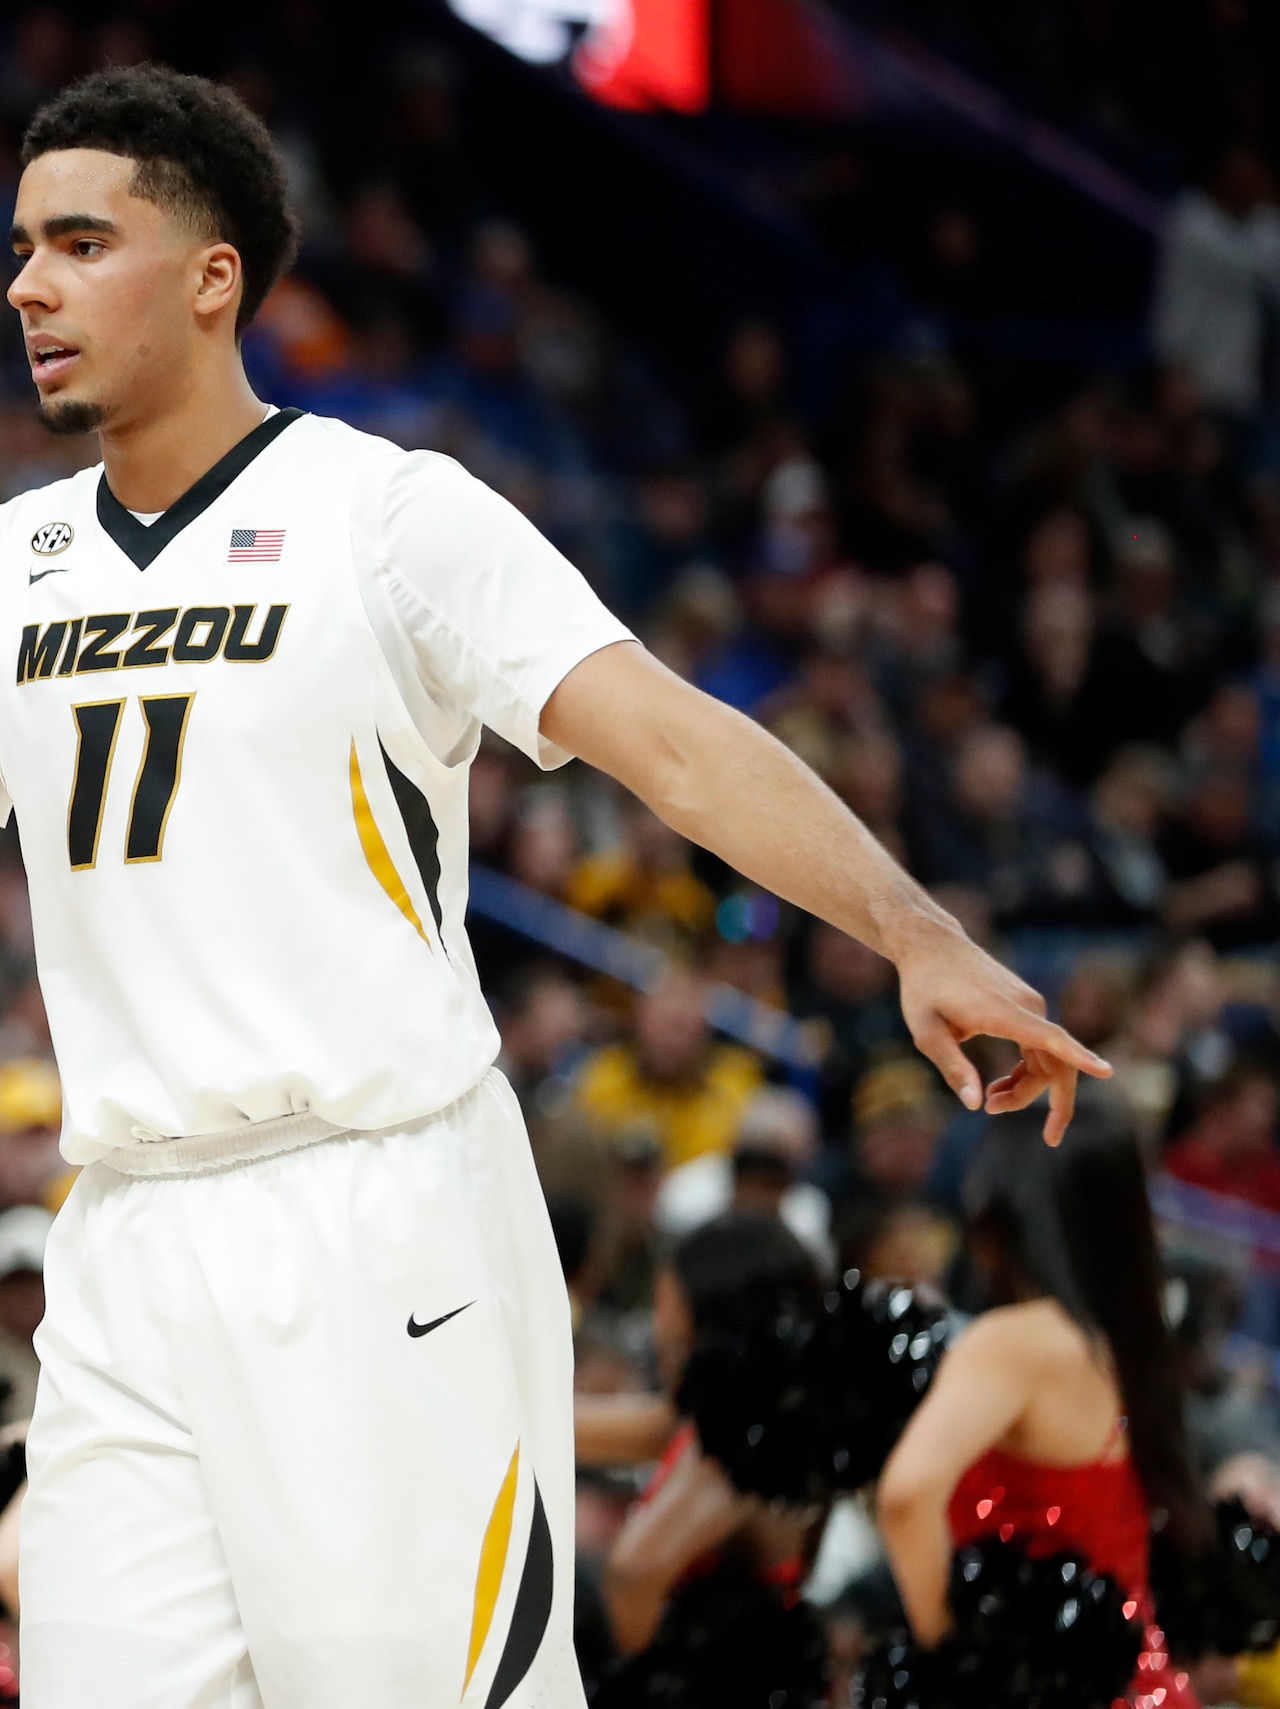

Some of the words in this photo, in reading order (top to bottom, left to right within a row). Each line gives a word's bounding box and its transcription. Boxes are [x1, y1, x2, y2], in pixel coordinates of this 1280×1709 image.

[31, 522, 72, 554] SEC
[16, 603, 292, 686] MIZZOU
[67, 691, 197, 872] 11
